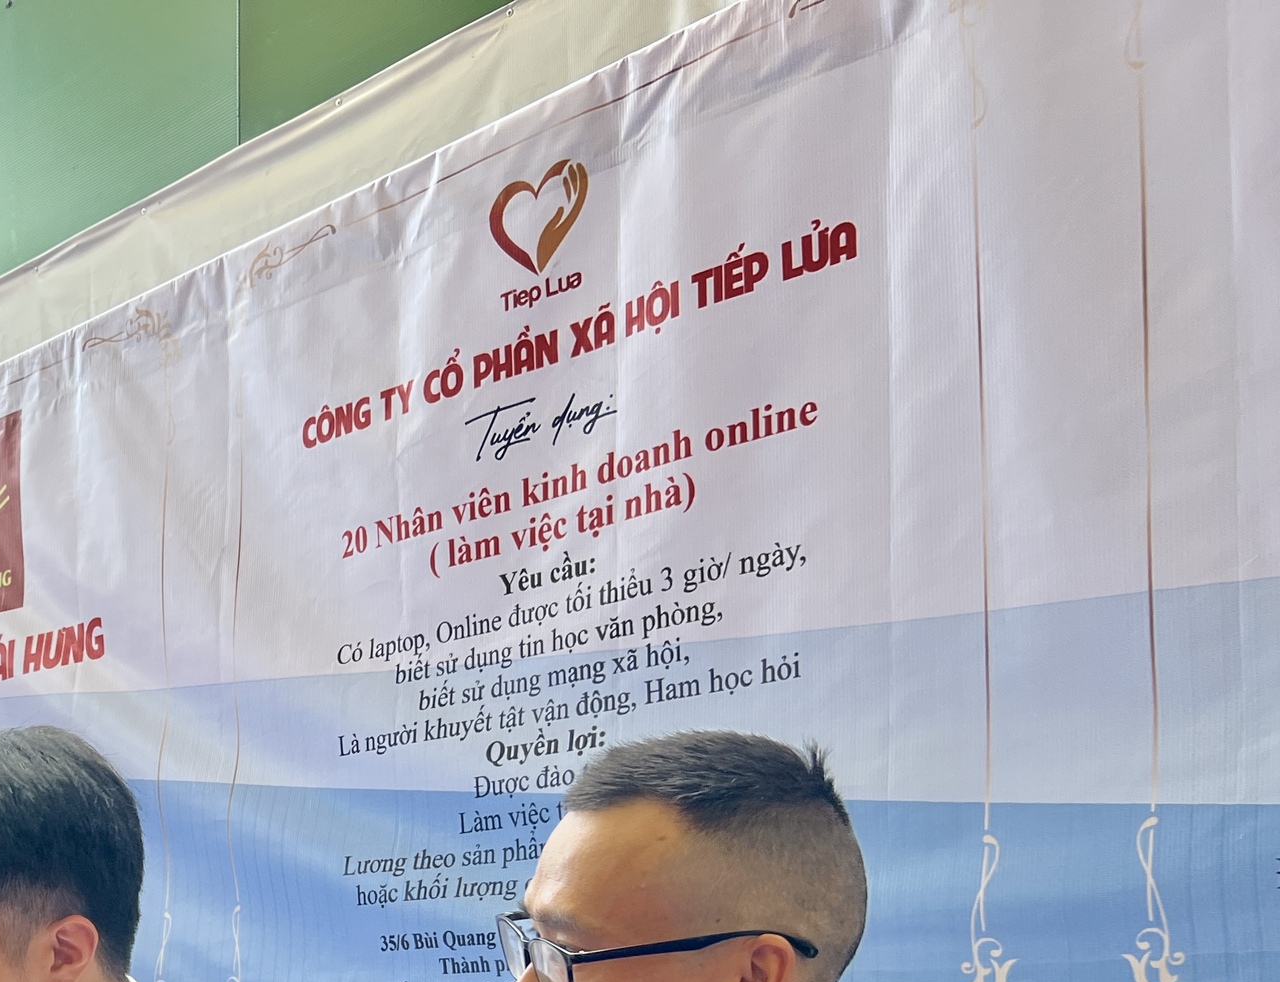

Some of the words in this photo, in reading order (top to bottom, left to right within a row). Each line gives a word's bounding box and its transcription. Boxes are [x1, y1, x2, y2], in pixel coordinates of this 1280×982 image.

[500, 285, 541, 312] Tiep
[546, 271, 583, 297] Lua
[302, 397, 372, 449] CÔNG
[380, 380, 414, 421] TY
[423, 348, 464, 404] CỔ
[473, 325, 559, 389] PHẦN
[569, 302, 615, 358] XÃ
[625, 280, 680, 336] HỘI
[691, 242, 769, 309] TIẾP
[781, 219, 857, 281] LỬA
[465, 397, 542, 462] Tuyển
[551, 393, 618, 445] dụng:
[341, 525, 370, 560] 20
[374, 505, 444, 550] Nhân
[452, 490, 512, 534] viên
[521, 463, 588, 509] kinh
[597, 432, 692, 486] doanh
[704, 400, 819, 454] online
[510, 516, 568, 560] việc
[575, 497, 616, 540] tại
[624, 471, 698, 523] nhà)
[499, 566, 543, 597] Yêu
[550, 550, 598, 588] cầu:
[337, 643, 364, 667] Có
[369, 626, 431, 664] laptop,
[436, 612, 502, 646] Online
[508, 602, 559, 632] được
[565, 581, 593, 613] tối
[599, 568, 653, 606] thiểu
[660, 567, 674, 592] 3
[683, 552, 731, 595] giờ/
[738, 541, 808, 578] ngày,
[22, 617, 105, 674] HƯNG
[395, 654, 432, 687] biết
[435, 648, 457, 677] sử
[469, 642, 512, 677] dụng
[518, 629, 546, 660] tin
[550, 625, 589, 655] học
[594, 616, 635, 640] văn
[641, 598, 724, 641] phòng,
[418, 680, 456, 713] biết
[461, 675, 484, 701] sử
[490, 671, 541, 703] dụng
[547, 660, 606, 691] mạng
[611, 646, 638, 675] xã
[645, 639, 691, 672] hội,
[339, 732, 359, 757] Là
[364, 722, 419, 755] người
[423, 704, 493, 742] khuyết
[499, 703, 526, 731] tật
[531, 696, 571, 727] vận
[575, 684, 638, 720] động,
[644, 675, 702, 706] Ham
[709, 664, 754, 702] học
[761, 651, 802, 681] hỏi
[486, 729, 559, 768] Quyền
[566, 726, 607, 754] lợi:
[474, 775, 529, 799] Được
[536, 765, 575, 789] đào
[458, 811, 503, 834] Làm
[508, 802, 551, 830] việc
[343, 853, 408, 877] Lương
[413, 845, 456, 870] theo
[462, 843, 497, 867] sản
[501, 830, 546, 870] phẩ
[356, 884, 399, 909] hoặc
[403, 869, 449, 902] khối
[455, 878, 518, 902] lượng
[380, 933, 410, 952] 35/6
[413, 928, 439, 950] Bùi
[442, 930, 497, 951] Quang
[438, 956, 491, 975] Thành
